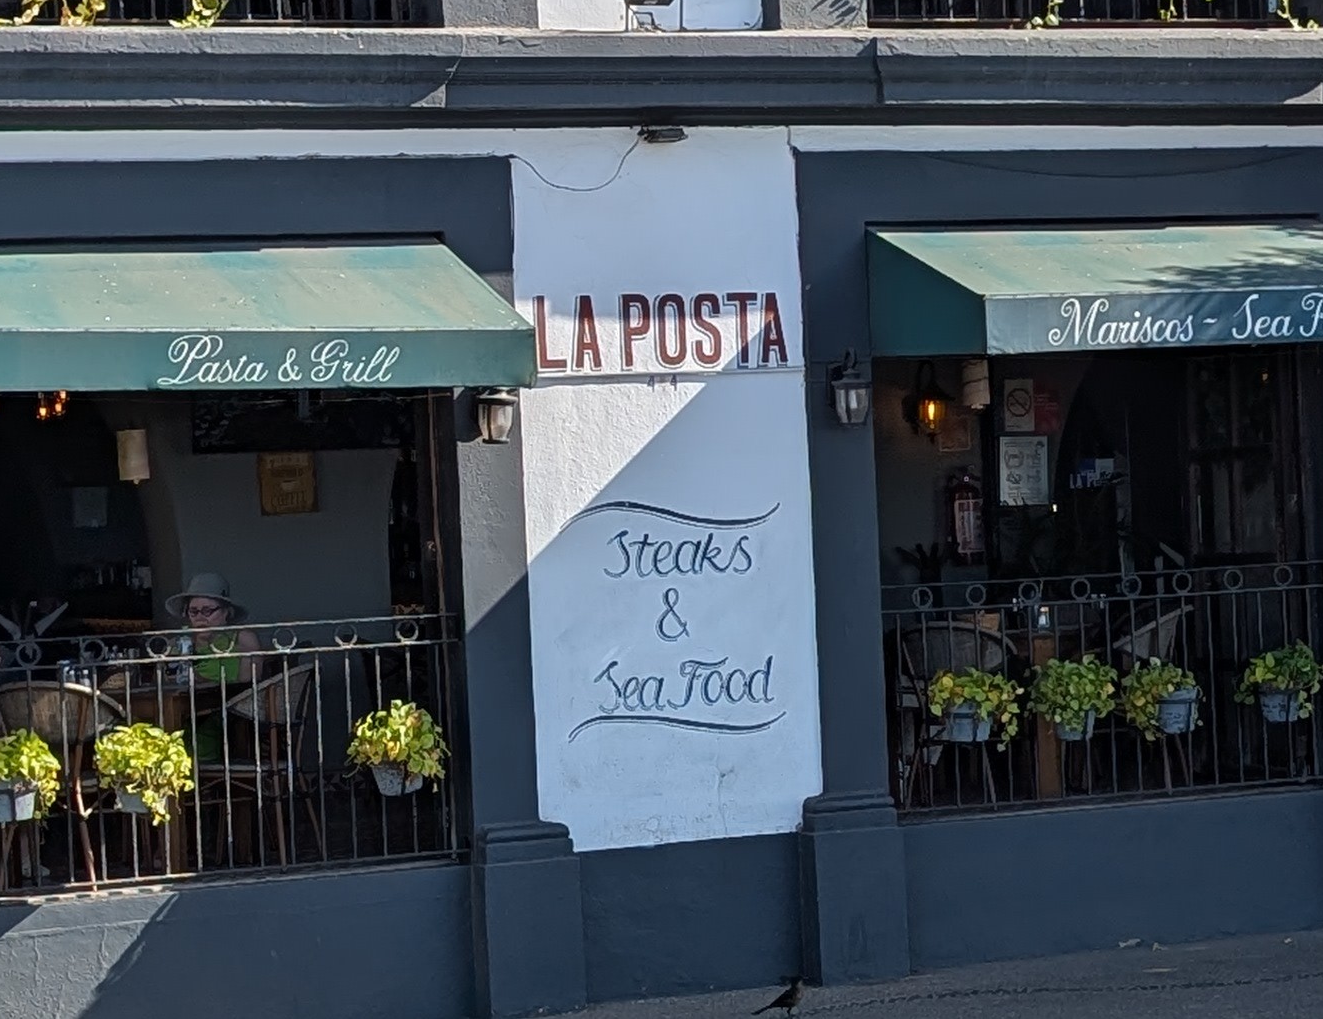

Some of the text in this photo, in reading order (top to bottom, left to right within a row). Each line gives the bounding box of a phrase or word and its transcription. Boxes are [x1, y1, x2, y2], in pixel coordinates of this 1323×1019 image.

[532, 292, 789, 373] LA POSTA
[1048, 297, 1195, 347] Mariscos
[1231, 293, 1294, 340] Sea
[157, 334, 401, 385] Pasta & Grill
[603, 530, 752, 578] Steaks
[655, 587, 690, 642] &
[593, 655, 775, 714] Sea Food
